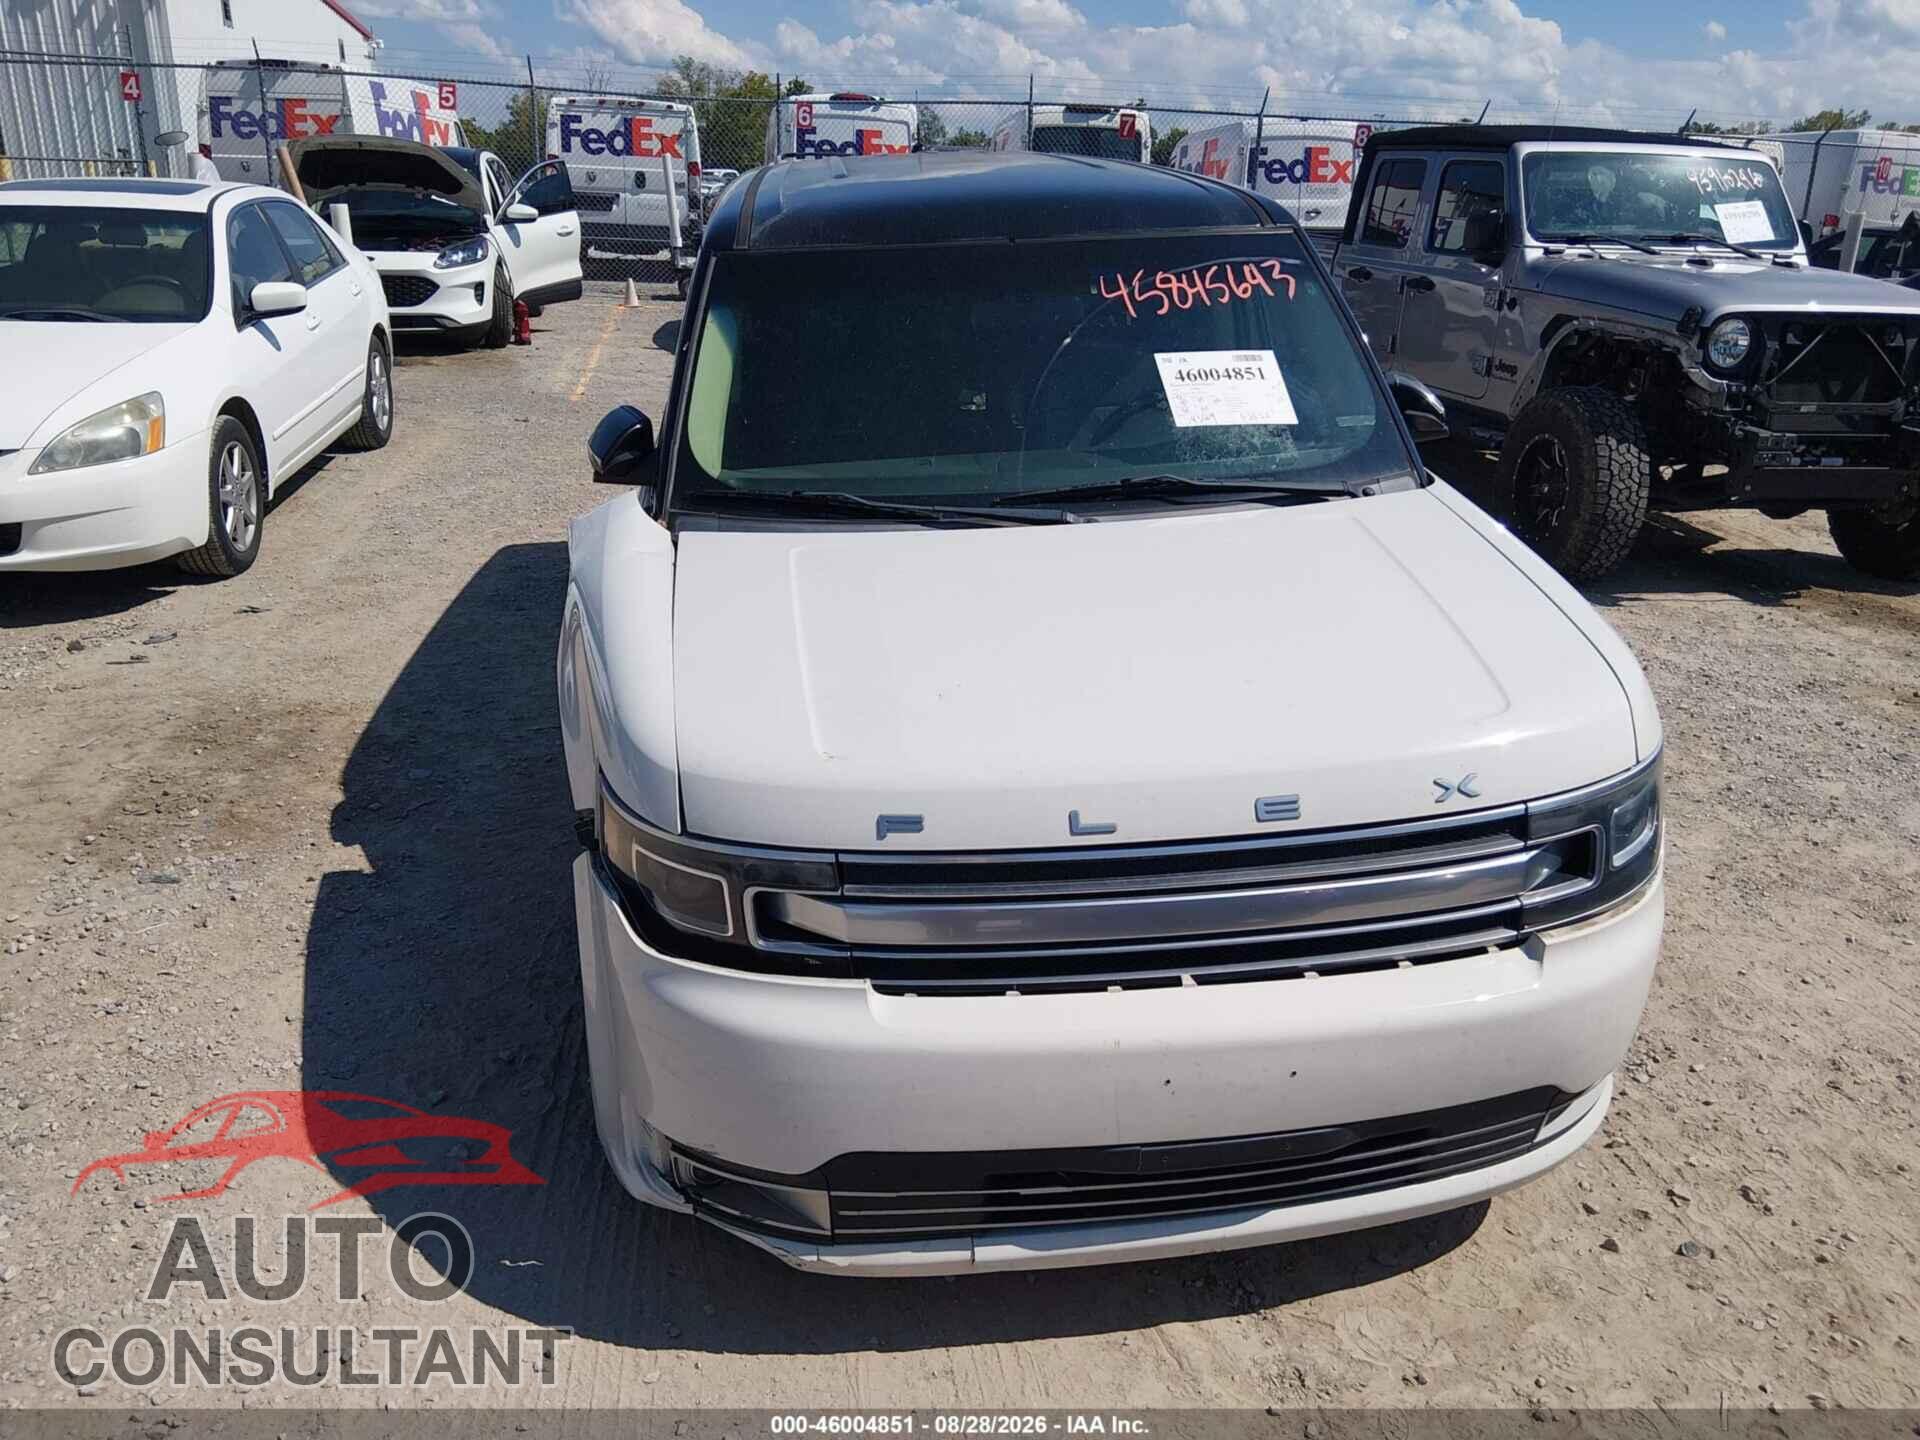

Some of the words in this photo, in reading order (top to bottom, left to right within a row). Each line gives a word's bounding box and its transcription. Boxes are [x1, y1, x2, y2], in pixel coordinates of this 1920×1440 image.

[123, 76, 140, 98] 4
[440, 86, 455, 108] 5
[209, 96, 341, 140] FedEx
[798, 105, 811, 127] 6
[1121, 115, 1134, 137] 7
[560, 114, 684, 159] FedEx
[1356, 127, 1369, 147] 8
[1247, 147, 1353, 185] FedEx
[1174, 366, 1267, 383] 46004851
